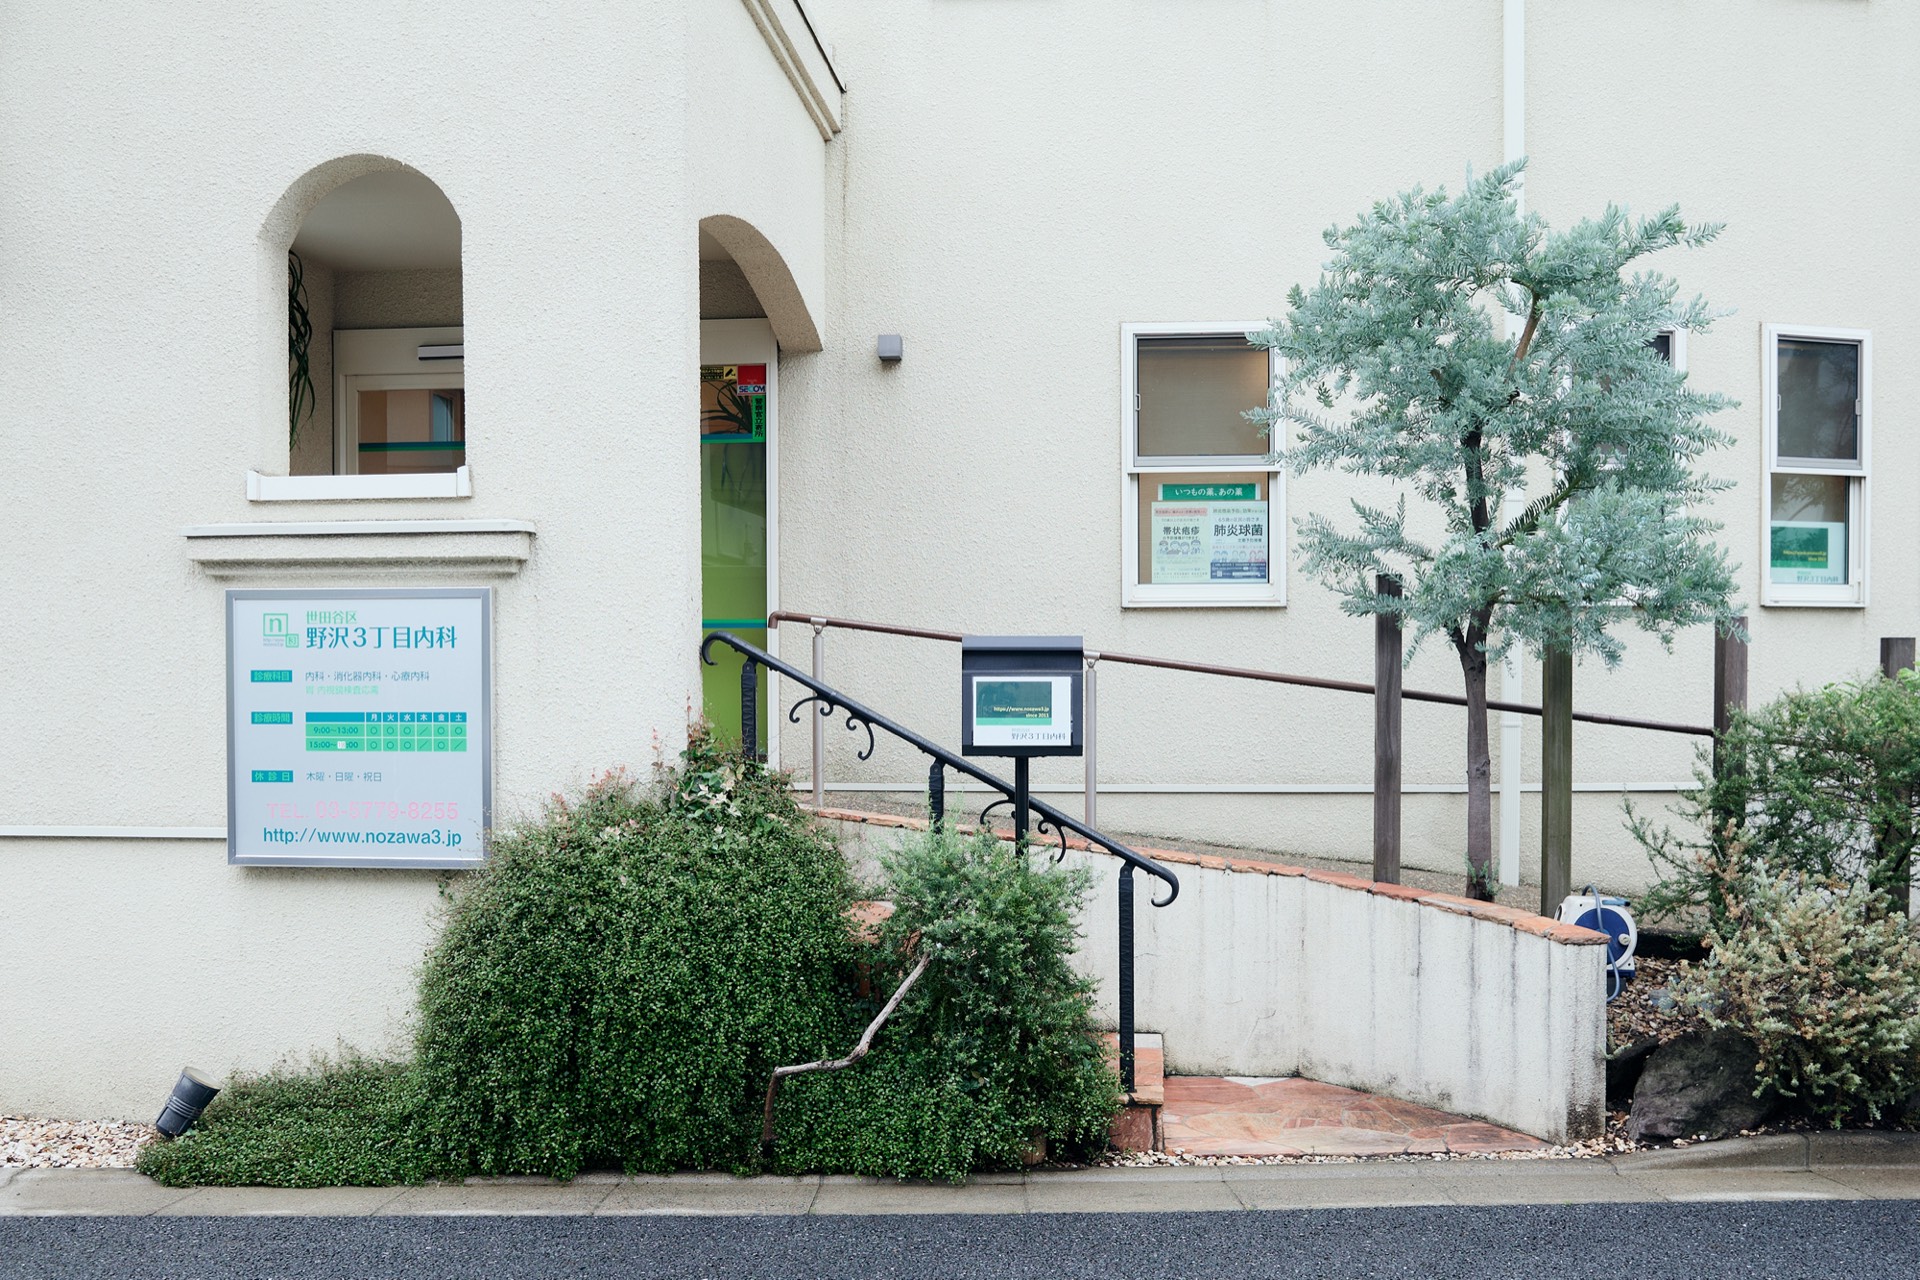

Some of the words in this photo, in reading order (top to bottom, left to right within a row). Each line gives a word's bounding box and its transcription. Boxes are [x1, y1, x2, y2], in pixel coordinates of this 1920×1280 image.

[739, 385, 766, 393] SECOM
[1175, 487, 1243, 497] いつもの薬、あの薬
[1163, 526, 1200, 535] 帯状疱疹
[1214, 524, 1263, 537] 肺炎球菌
[306, 610, 357, 625] 世田谷区
[306, 626, 457, 649] 野沢3丁目内科
[254, 671, 290, 682] 診療科目
[305, 671, 430, 682] 内科・消化器内科・心療内科
[254, 713, 291, 724] 診療時間
[370, 713, 378, 722] 月
[387, 713, 395, 722] 火
[403, 713, 412, 722] 水
[420, 713, 429, 722] 木
[437, 713, 445, 722] 金
[455, 713, 463, 722] 土
[306, 771, 382, 782] 木曜・日曜・祝日
[315, 801, 460, 821] 03-5779-8255
[263, 827, 462, 847] http://www.nozawa3.jp
